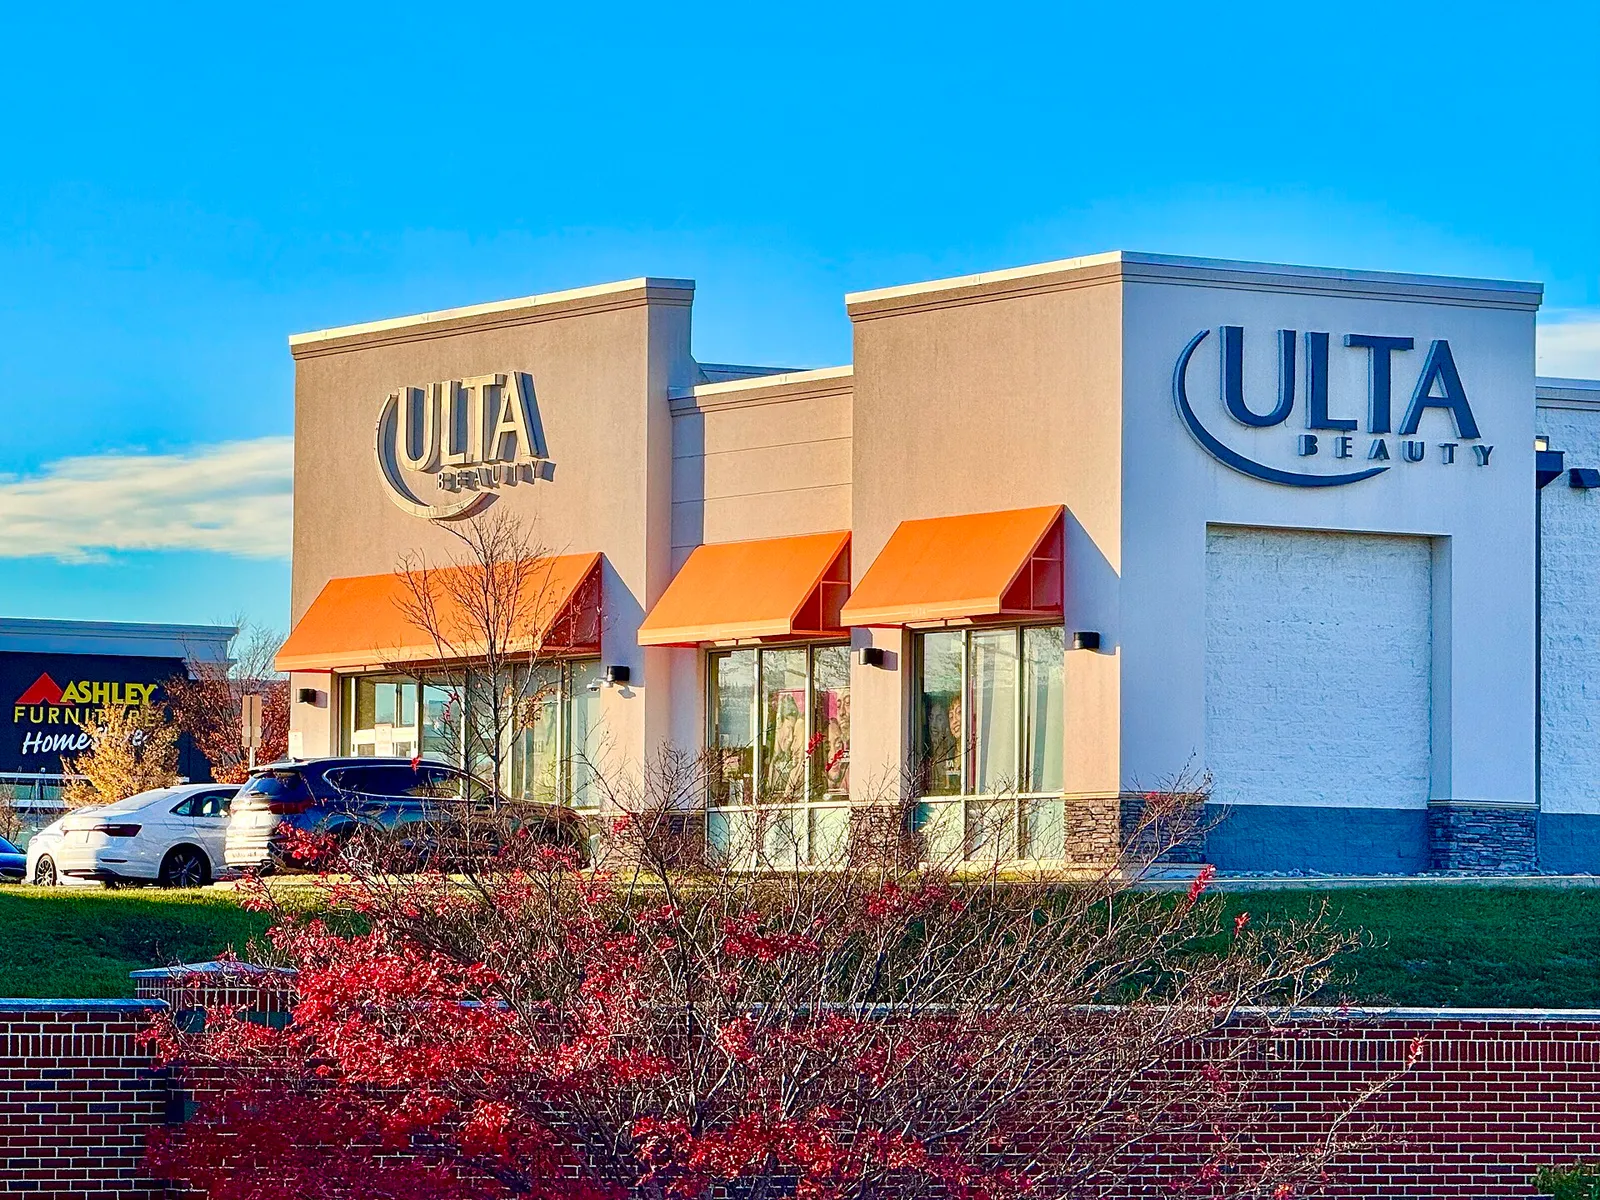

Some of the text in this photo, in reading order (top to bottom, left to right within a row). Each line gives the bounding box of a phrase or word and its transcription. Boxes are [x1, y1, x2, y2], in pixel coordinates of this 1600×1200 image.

[1220, 326, 1481, 439] ULTA
[396, 371, 546, 472] ULTA
[1299, 435, 1493, 466] BEAUTY
[437, 461, 547, 491] BEAUTY
[60, 681, 157, 705] ASHLEY
[14, 706, 155, 727] FURNITRE
